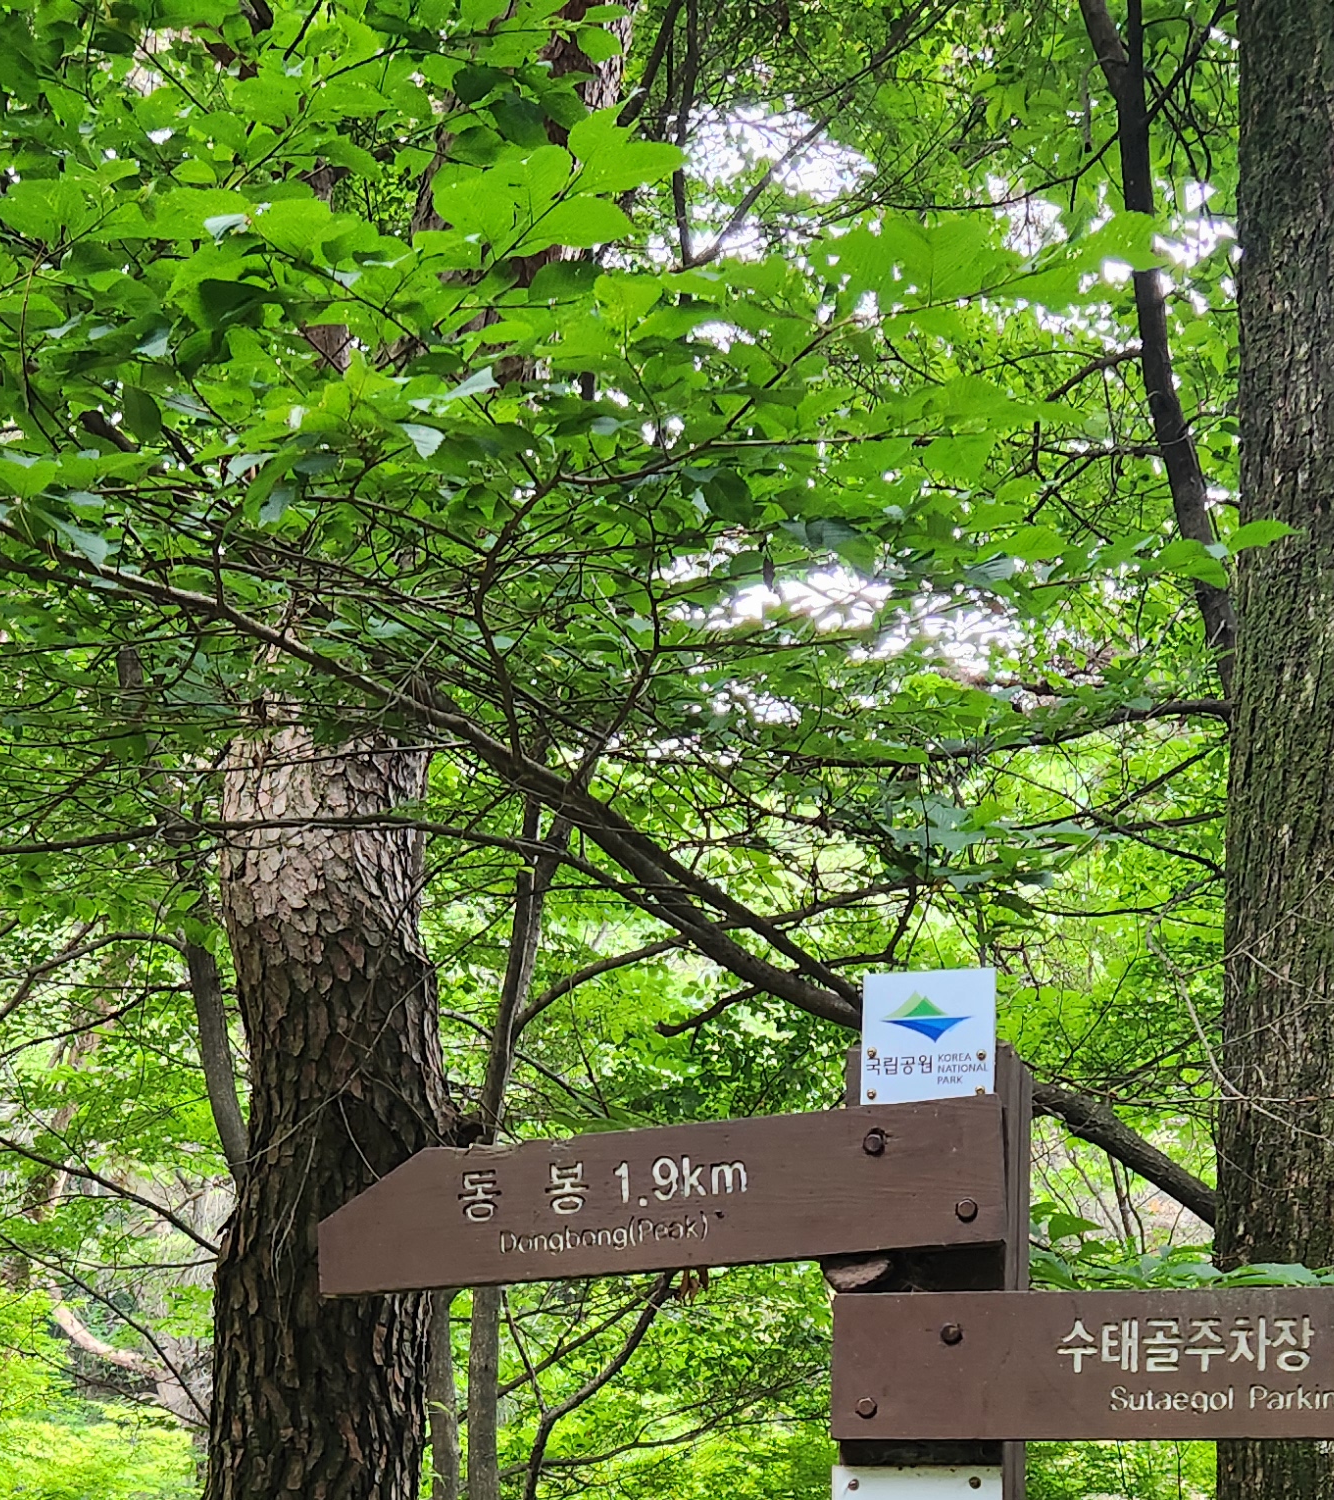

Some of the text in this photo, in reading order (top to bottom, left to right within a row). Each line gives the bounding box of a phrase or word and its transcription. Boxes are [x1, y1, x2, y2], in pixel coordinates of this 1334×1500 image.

[866, 1054, 933, 1076] 국립공원
[937, 1052, 972, 1063] KOREA
[937, 1063, 989, 1074] NATIONAL
[937, 1075, 963, 1085] PARK
[612, 1153, 748, 1208] 1.9km
[1057, 1316, 1314, 1374] 수태골주차장
[1109, 1385, 1234, 1415] Sutaegol
